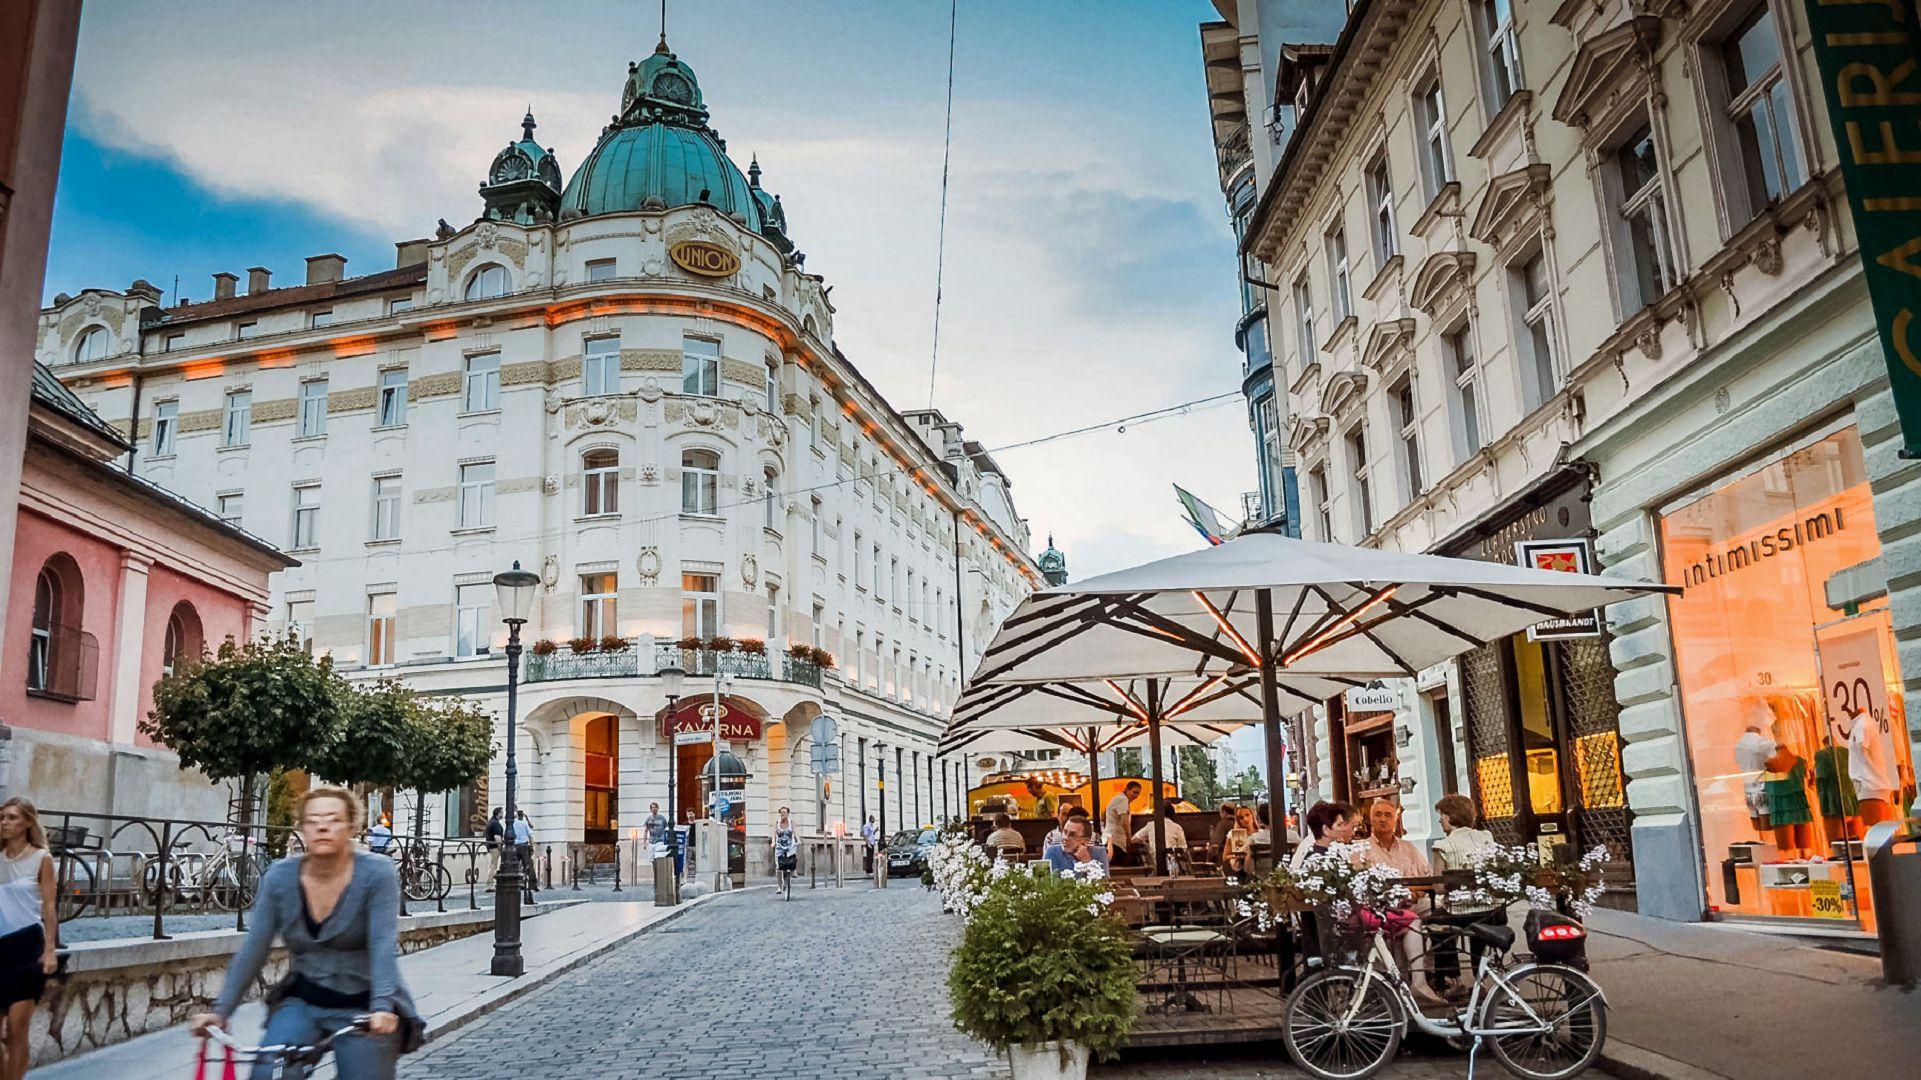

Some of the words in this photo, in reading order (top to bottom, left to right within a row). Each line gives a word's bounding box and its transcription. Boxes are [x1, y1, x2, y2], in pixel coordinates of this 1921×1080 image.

[681, 246, 732, 271] UNION
[1481, 506, 1546, 557] ZLATARSTVO
[1684, 507, 1844, 588] intimissimi
[1536, 618, 1594, 630] HAUSBRANDT
[1812, 897, 1842, 913] -30%
